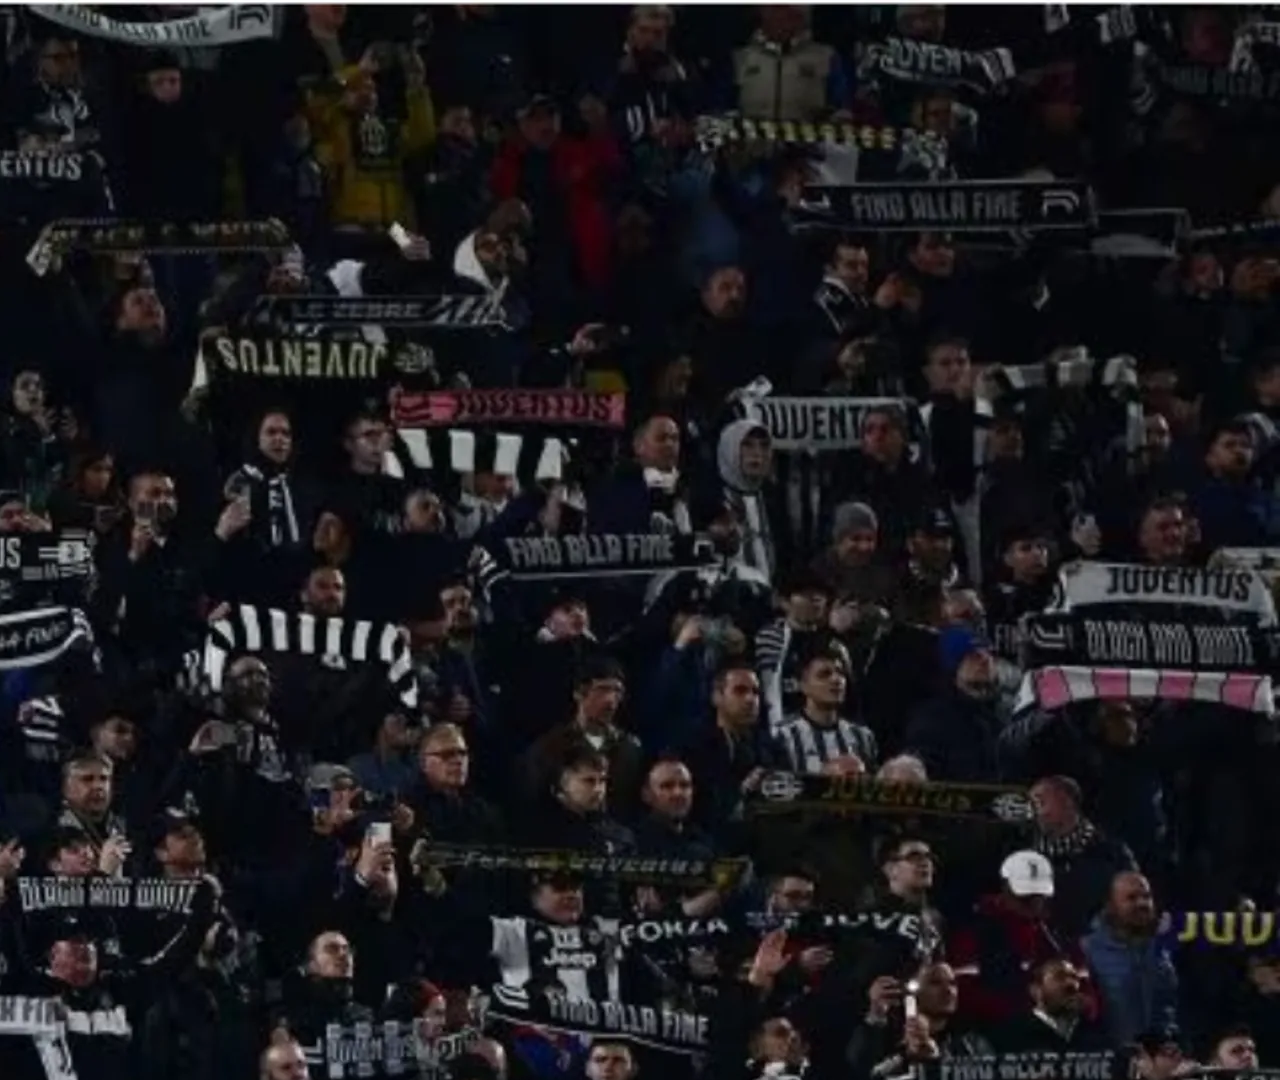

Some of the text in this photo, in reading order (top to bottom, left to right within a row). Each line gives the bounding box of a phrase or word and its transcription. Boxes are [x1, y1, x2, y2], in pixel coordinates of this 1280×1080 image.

[216, 336, 390, 378] JUVENTUS
[756, 400, 866, 439] JUVENT
[1104, 564, 1252, 600] JUVENTUS
[661, 1006, 711, 1044] FINE
